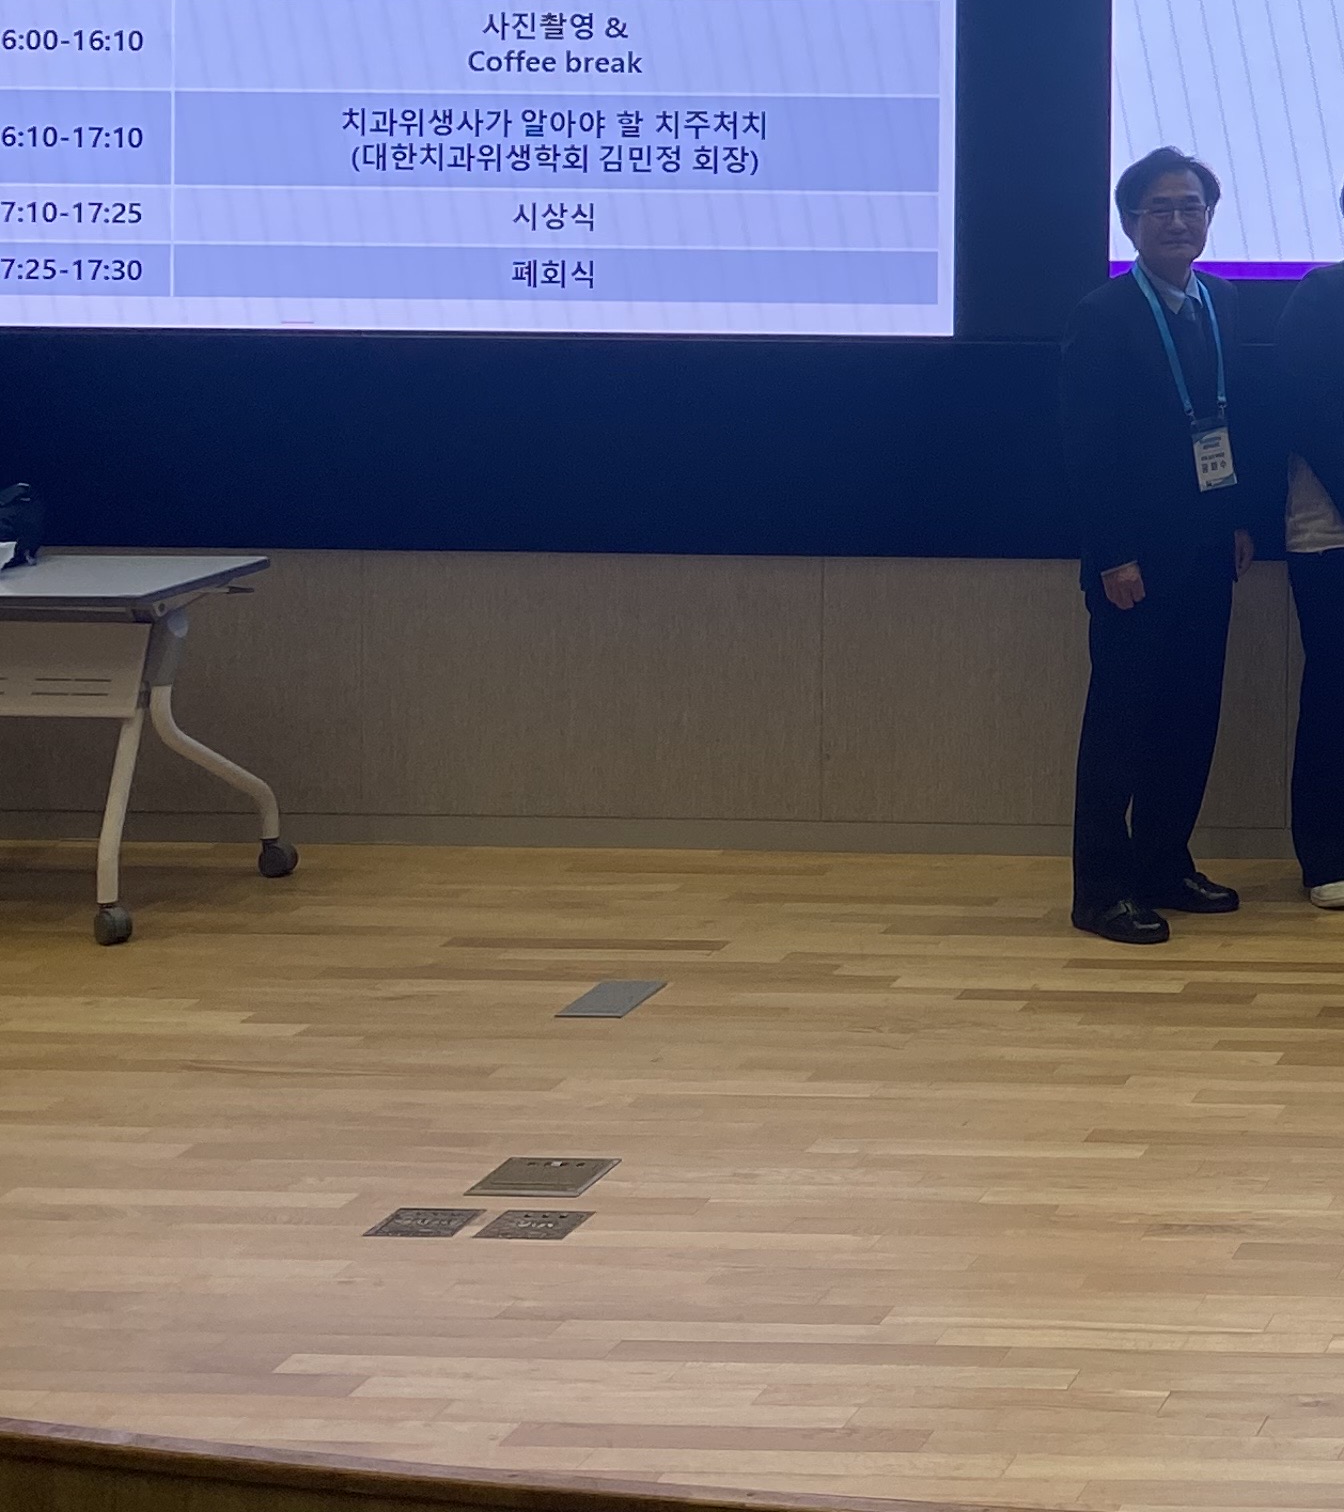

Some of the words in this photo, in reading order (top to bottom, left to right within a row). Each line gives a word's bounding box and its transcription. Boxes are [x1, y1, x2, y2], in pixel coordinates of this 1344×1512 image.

[483, 12, 593, 40] 사진촬영
[605, 18, 628, 38] &
[469, 50, 556, 72] Coffee
[567, 51, 642, 73] break
[343, 108, 512, 137] 치과위생사가
[522, 110, 605, 138] 알아야
[617, 111, 643, 137] 할
[656, 111, 765, 140] 치주처치
[352, 143, 587, 173] (대한치과위생학회
[600, 145, 680, 172] 김민정
[693, 146, 758, 175] 회장)
[513, 203, 593, 231] 시상식
[512, 260, 593, 288] 폐회식
